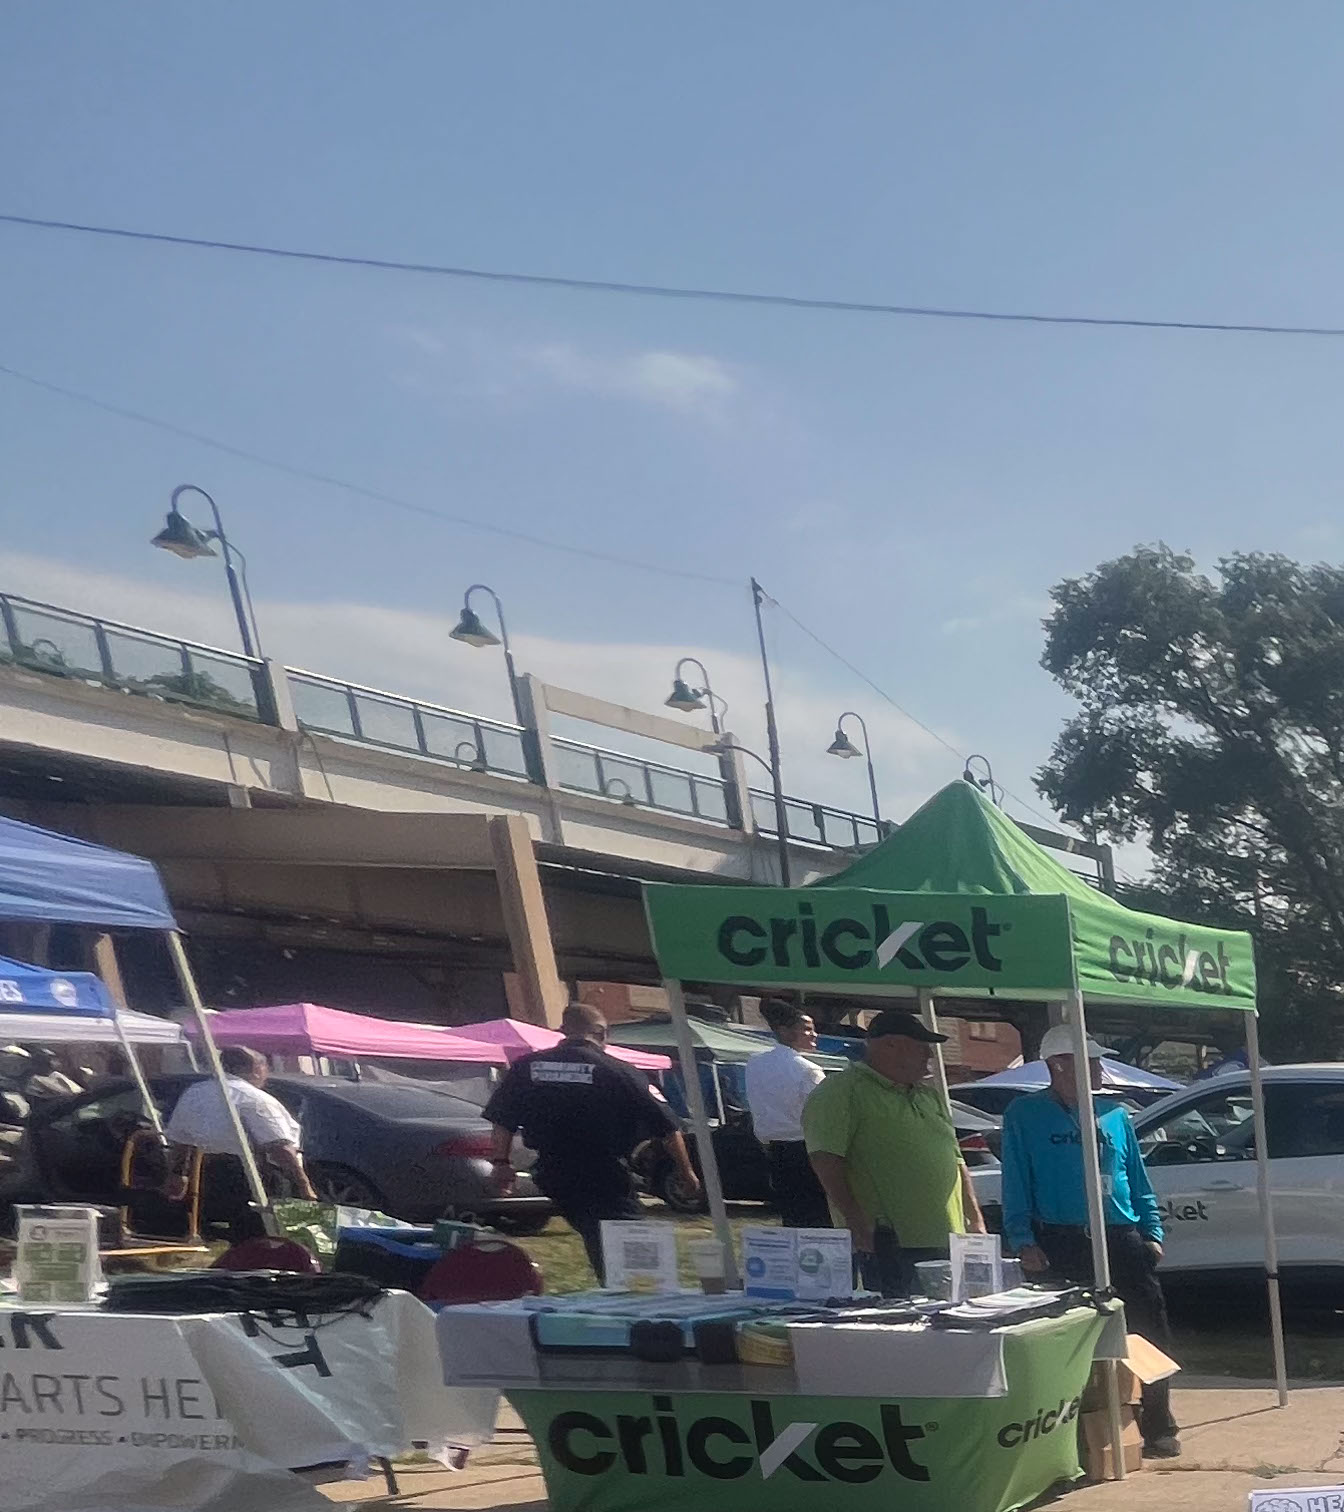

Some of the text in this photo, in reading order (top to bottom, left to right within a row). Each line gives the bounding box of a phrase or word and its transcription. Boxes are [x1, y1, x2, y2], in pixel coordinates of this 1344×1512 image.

[718, 902, 1003, 971] cricket
[1109, 928, 1231, 994] cricket
[547, 1395, 932, 1482] cricket
